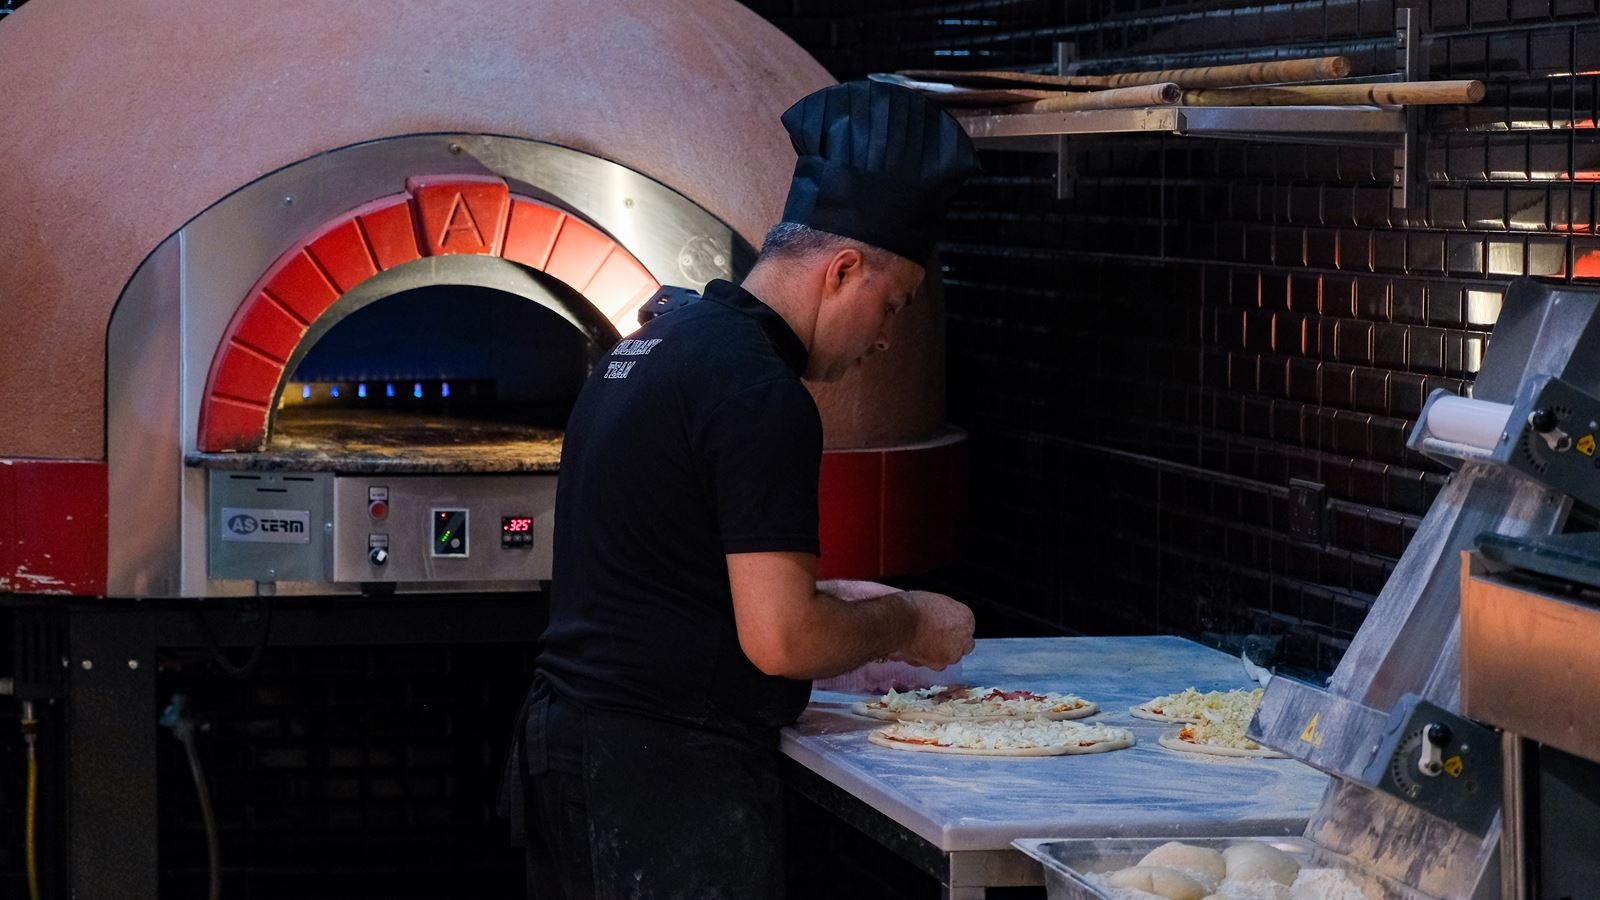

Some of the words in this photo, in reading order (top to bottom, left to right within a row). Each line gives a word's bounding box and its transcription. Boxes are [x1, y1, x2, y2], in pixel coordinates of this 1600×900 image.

[438, 192, 485, 247] A
[604, 361, 636, 379] TEAM
[231, 517, 256, 532] AS
